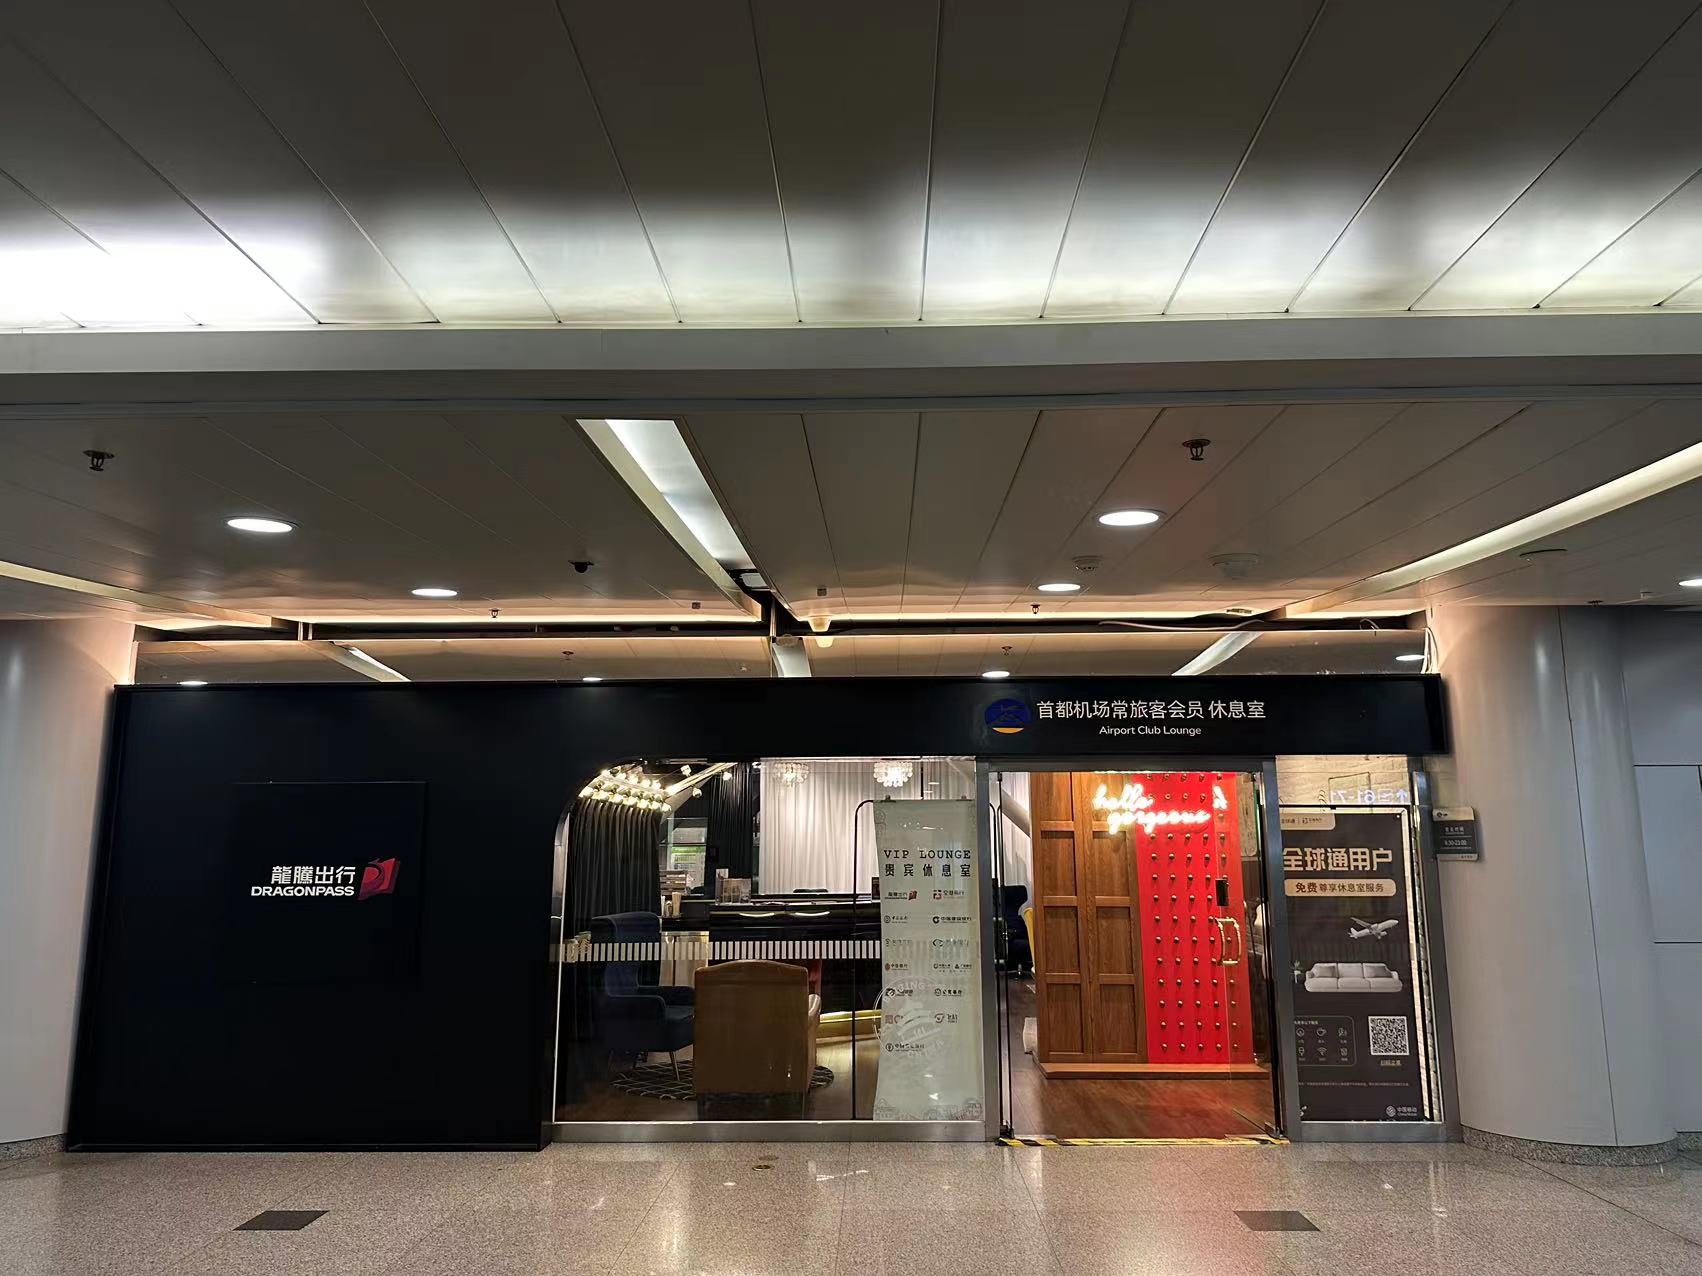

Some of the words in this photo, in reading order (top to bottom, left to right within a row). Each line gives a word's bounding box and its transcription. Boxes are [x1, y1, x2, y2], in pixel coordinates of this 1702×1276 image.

[1036, 700, 1204, 720] 首都机场常旅客会员
[1208, 700, 1266, 720] 休息室
[1099, 725, 1136, 737] Airport
[1138, 725, 1161, 736] Club
[1163, 726, 1202, 738] Lounge
[884, 849, 910, 859] VIP
[920, 849, 971, 859] LOUNGE
[1282, 847, 1393, 871] 全球通用户
[270, 865, 356, 885] 龍騰出行
[885, 863, 971, 878] 贵宾休息室
[250, 886, 355, 897] DRAGONPASS
